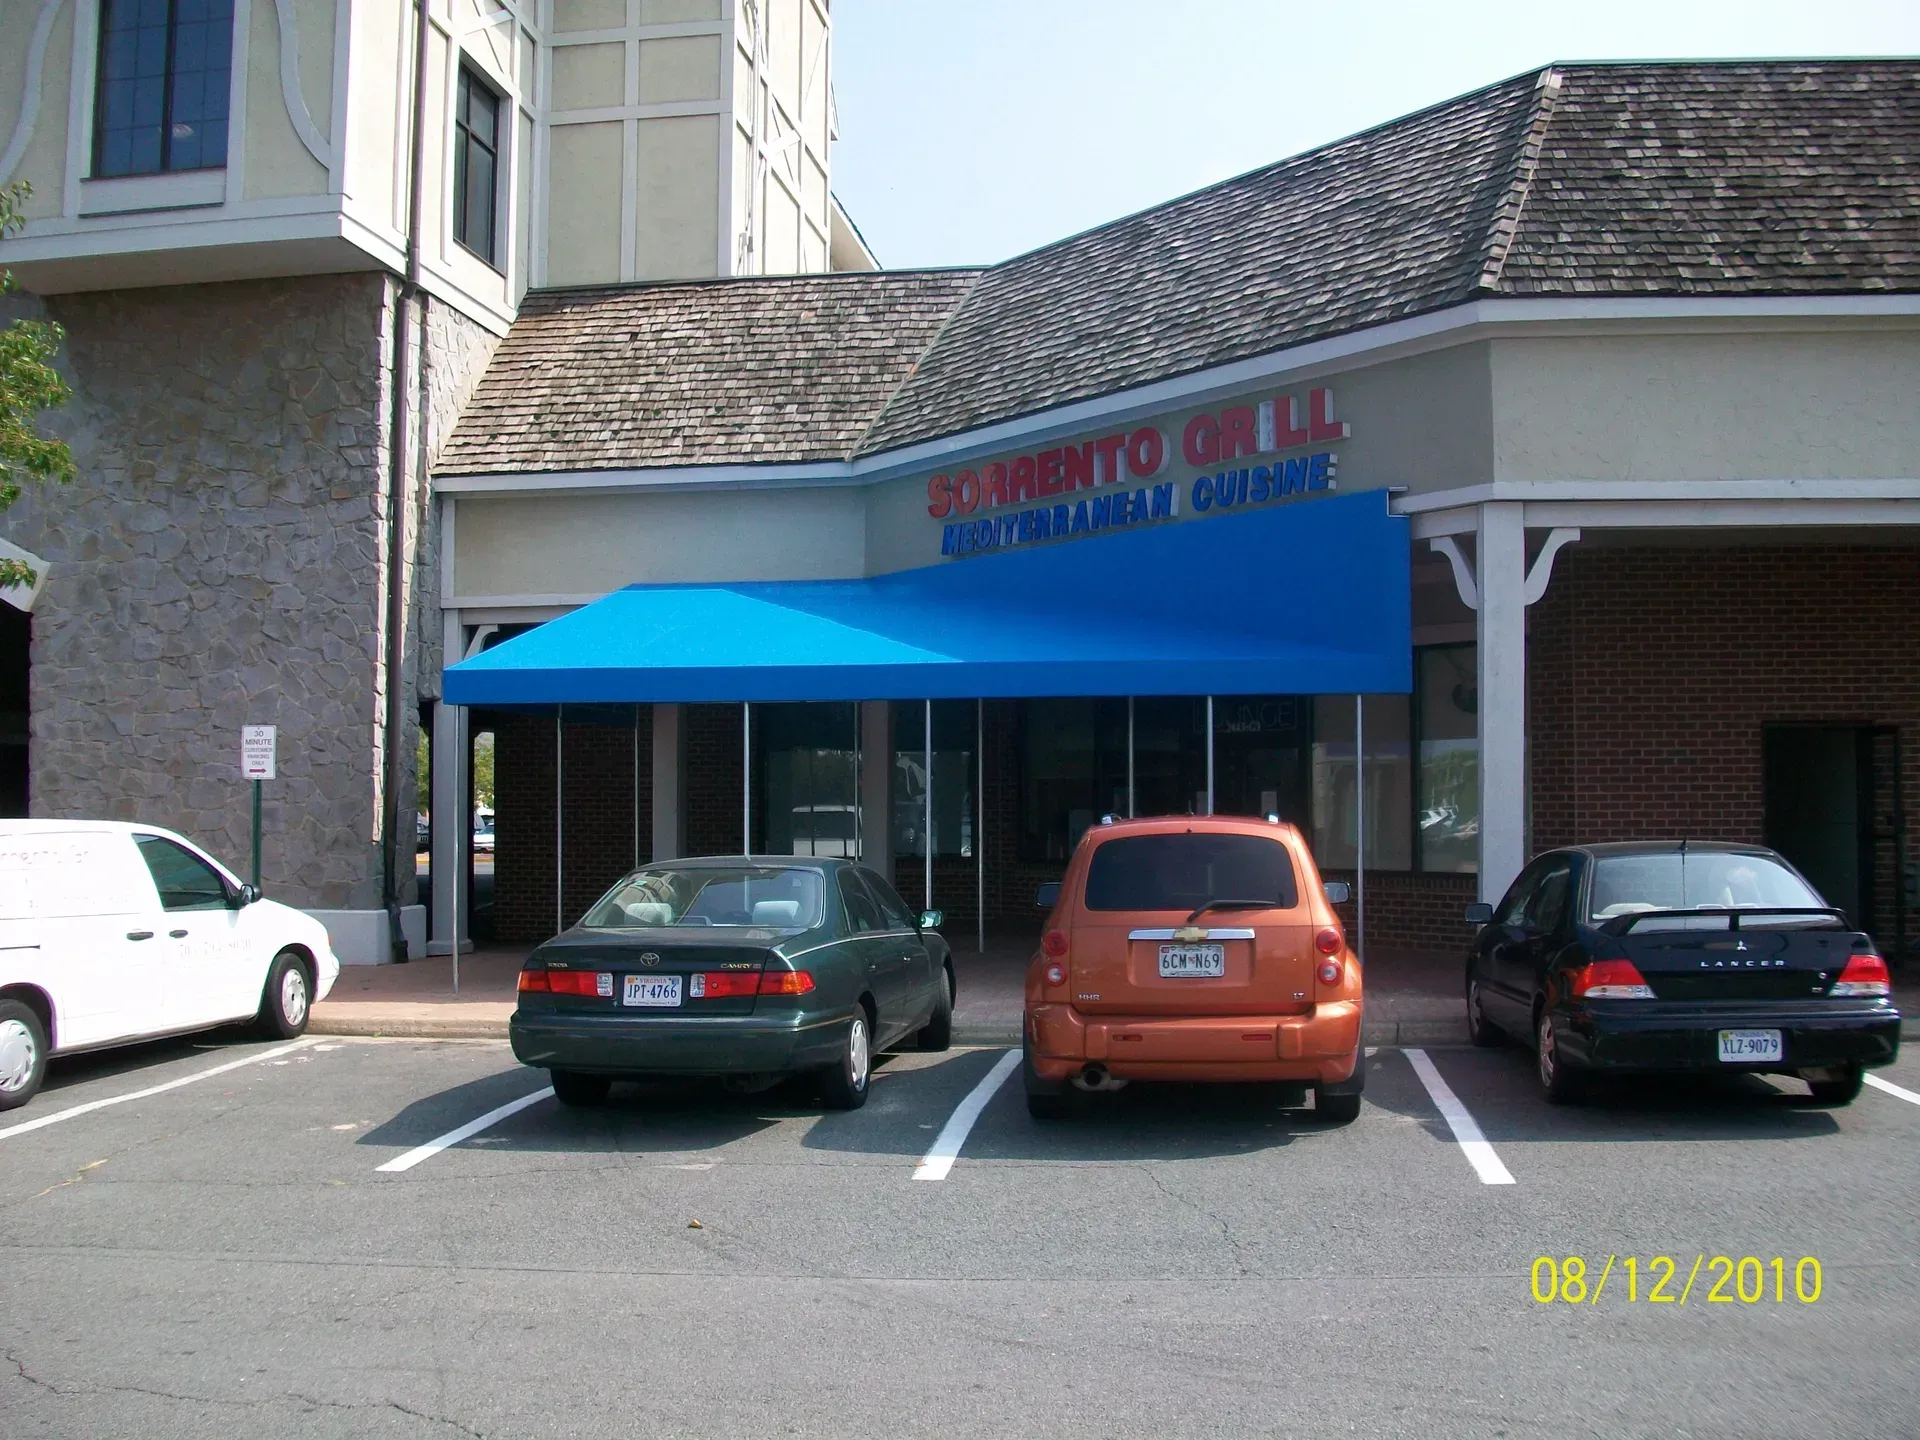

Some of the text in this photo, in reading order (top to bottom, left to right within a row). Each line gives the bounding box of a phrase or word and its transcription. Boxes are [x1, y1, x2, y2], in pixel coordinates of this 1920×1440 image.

[928, 387, 1350, 519] SORRENTO GRILL
[941, 453, 1338, 556] MEDITERRANEAN CUISINE
[1722, 1039, 1779, 1054] XLZ-9079
